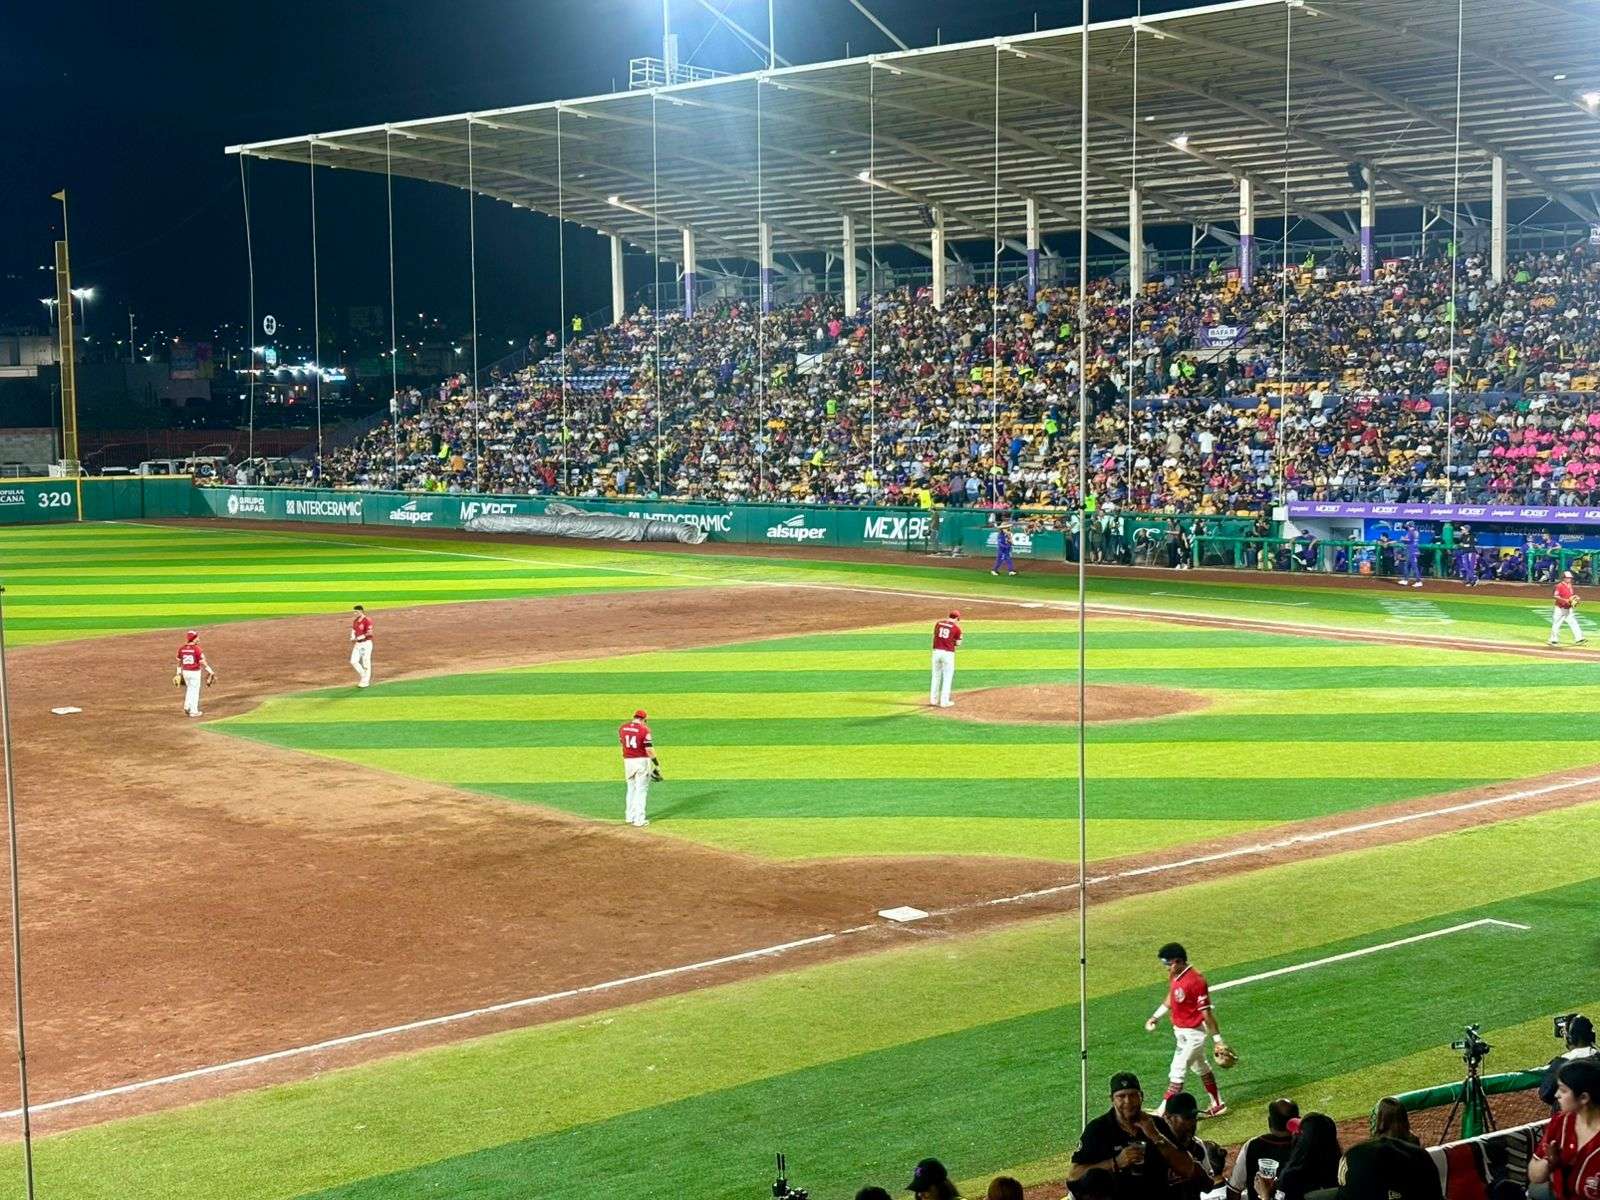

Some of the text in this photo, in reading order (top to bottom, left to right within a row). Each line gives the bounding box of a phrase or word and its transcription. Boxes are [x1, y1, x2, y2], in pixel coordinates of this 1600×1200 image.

[38, 491, 72, 508] 320
[296, 500, 362, 516] INTERCERAMIC
[389, 508, 434, 524] alsuper
[766, 524, 827, 542] alsuper
[938, 626, 950, 639] 19
[625, 734, 638, 748] 14
